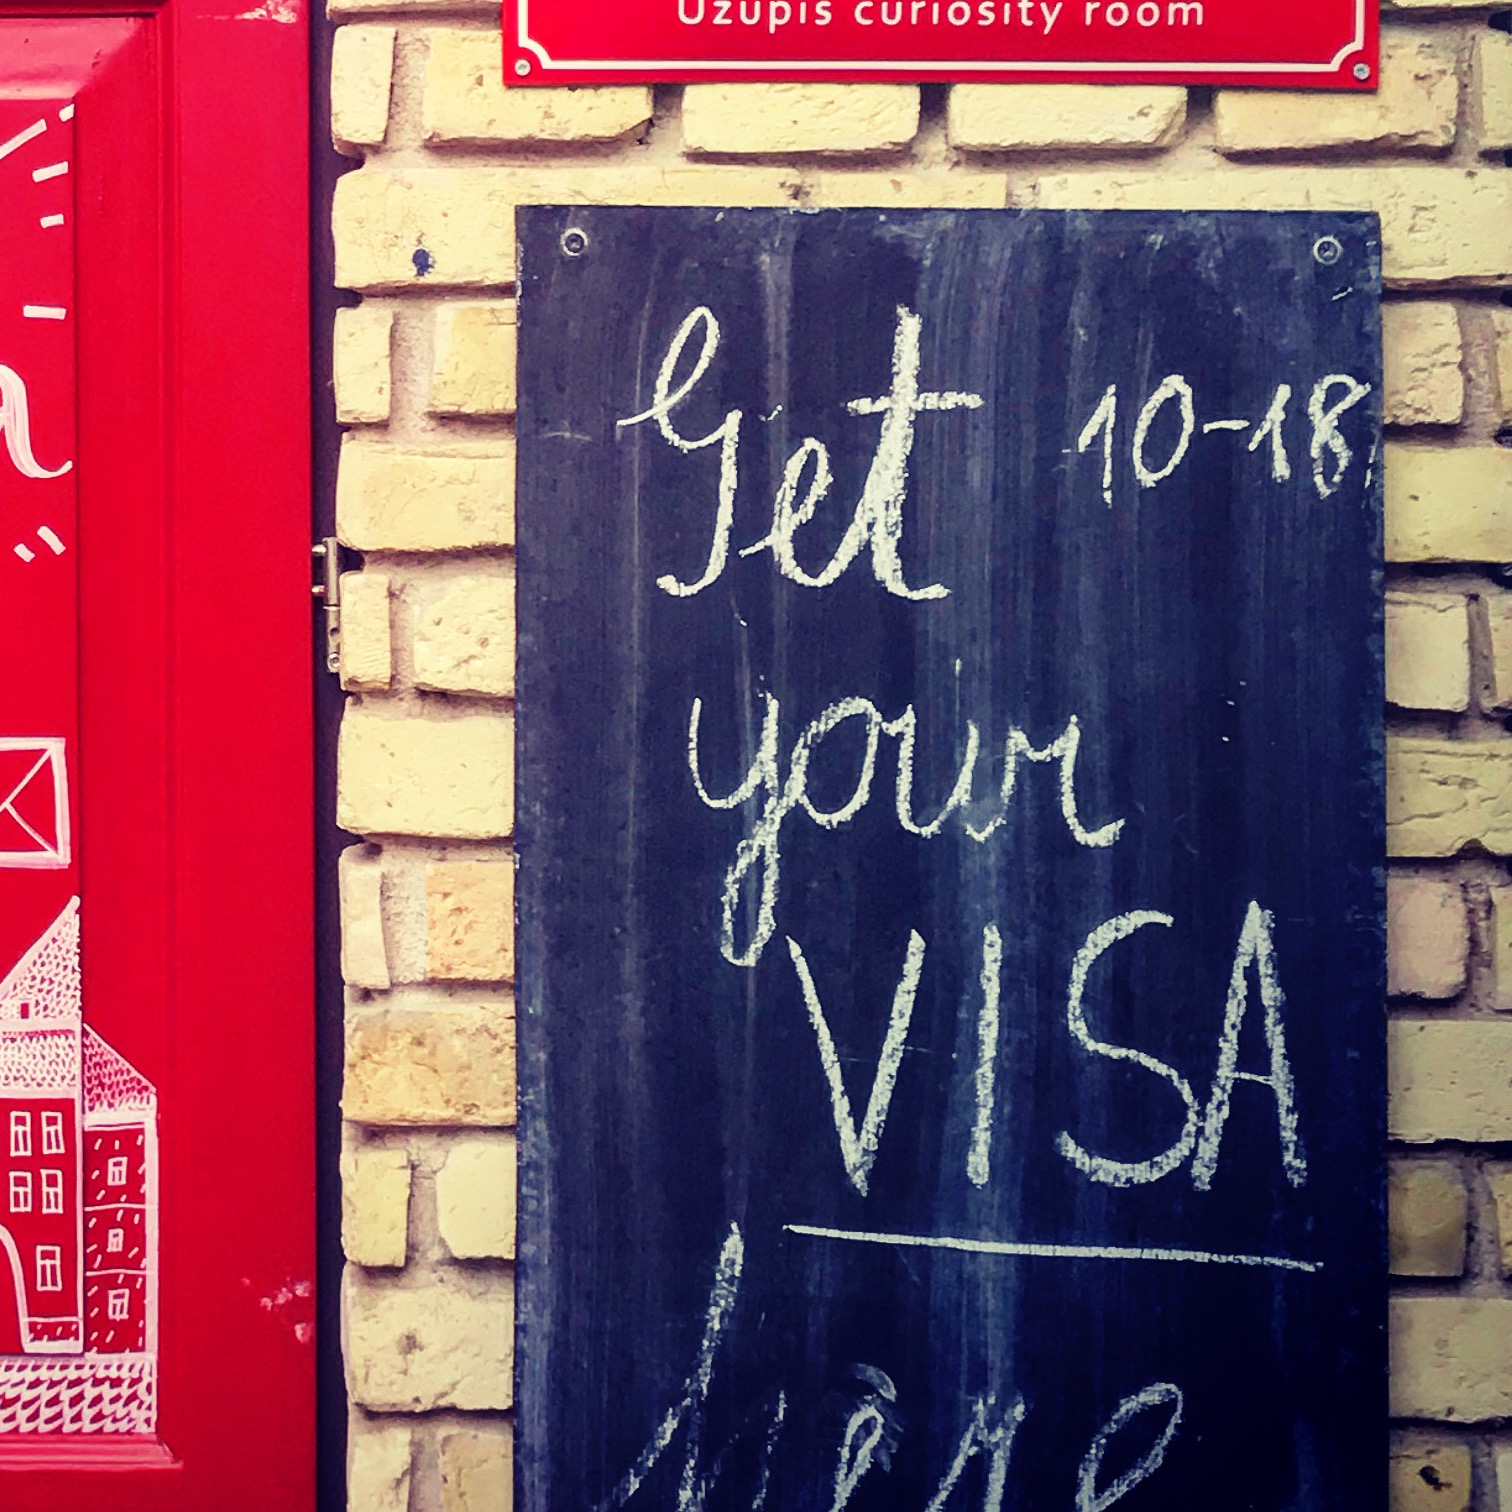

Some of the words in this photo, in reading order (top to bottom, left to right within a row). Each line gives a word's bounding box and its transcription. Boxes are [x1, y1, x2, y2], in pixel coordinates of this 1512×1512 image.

[1084, 0, 1206, 27] room
[618, 305, 985, 600] Get
[1076, 372, 1374, 508] 10-18
[688, 691, 1126, 967] your
[786, 899, 1310, 1197] VISA
